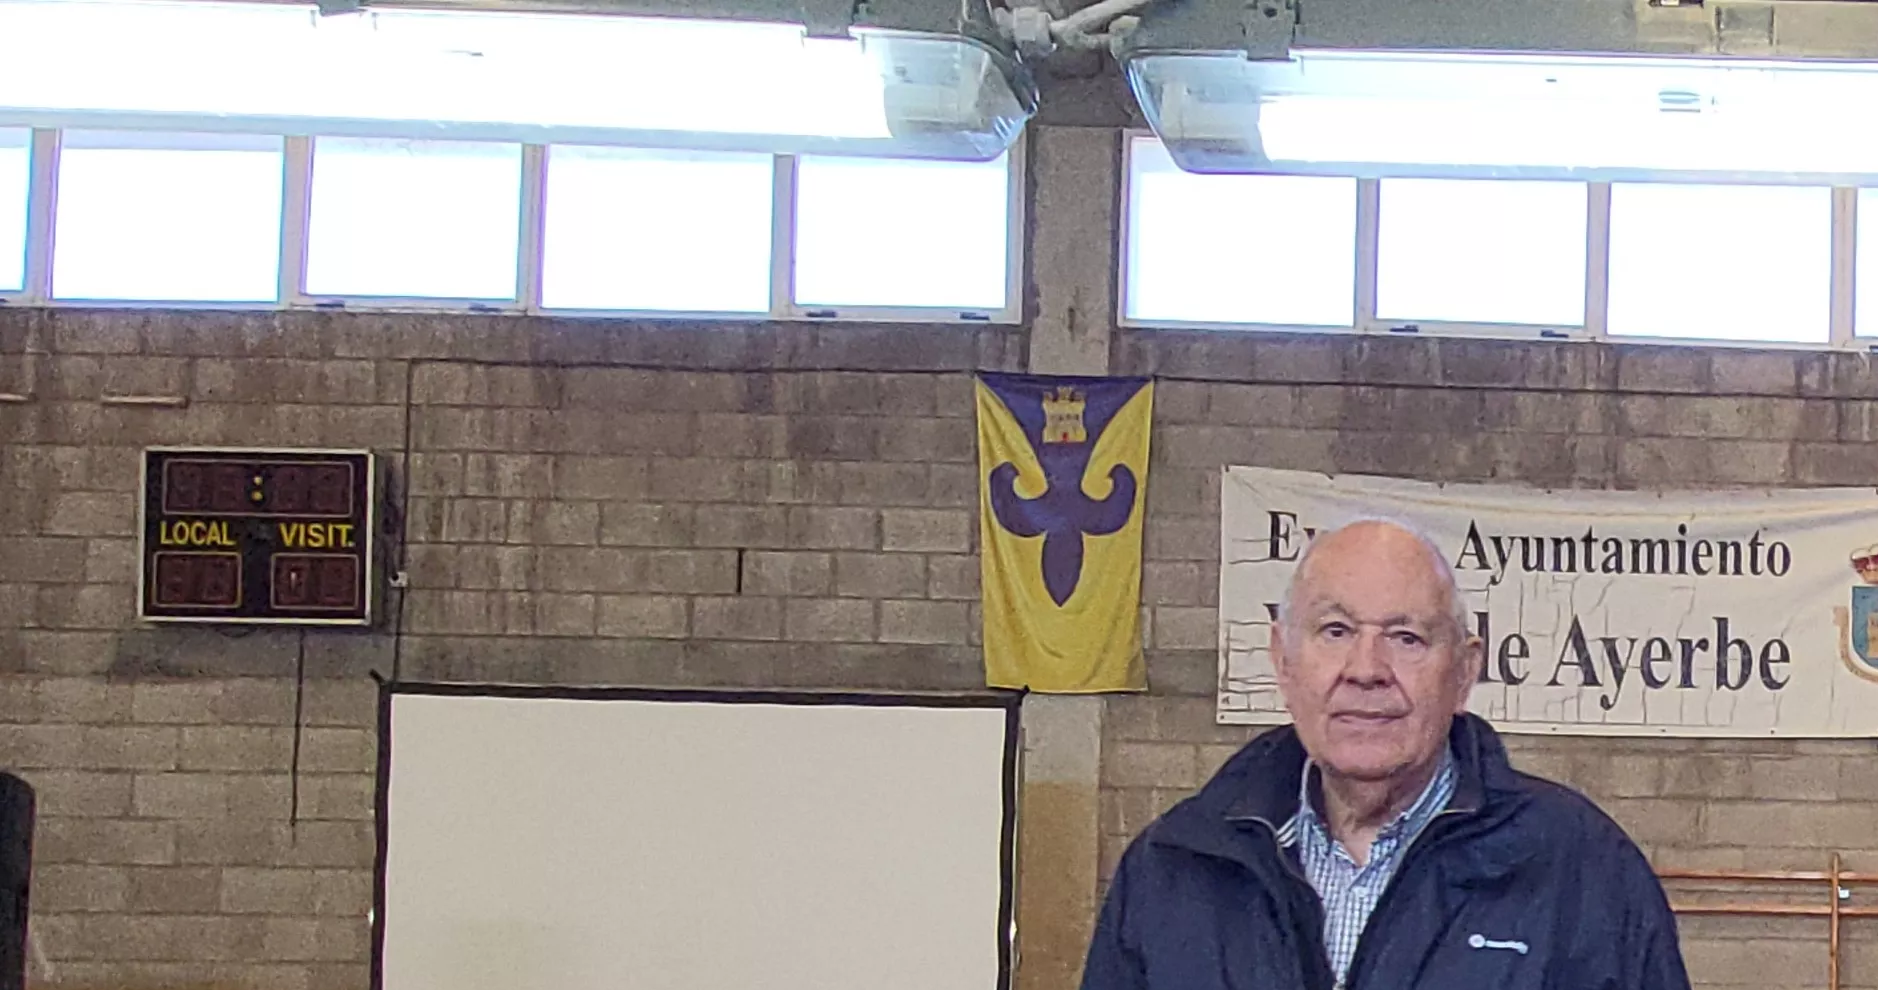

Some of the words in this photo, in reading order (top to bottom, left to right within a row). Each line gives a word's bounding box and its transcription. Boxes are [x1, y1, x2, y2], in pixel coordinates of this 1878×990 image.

[159, 520, 236, 545] LOCAL
[279, 522, 356, 548] VISIT.
[1454, 519, 1792, 586] Ayuntamiento
[1547, 614, 1792, 710] Ayerbe
